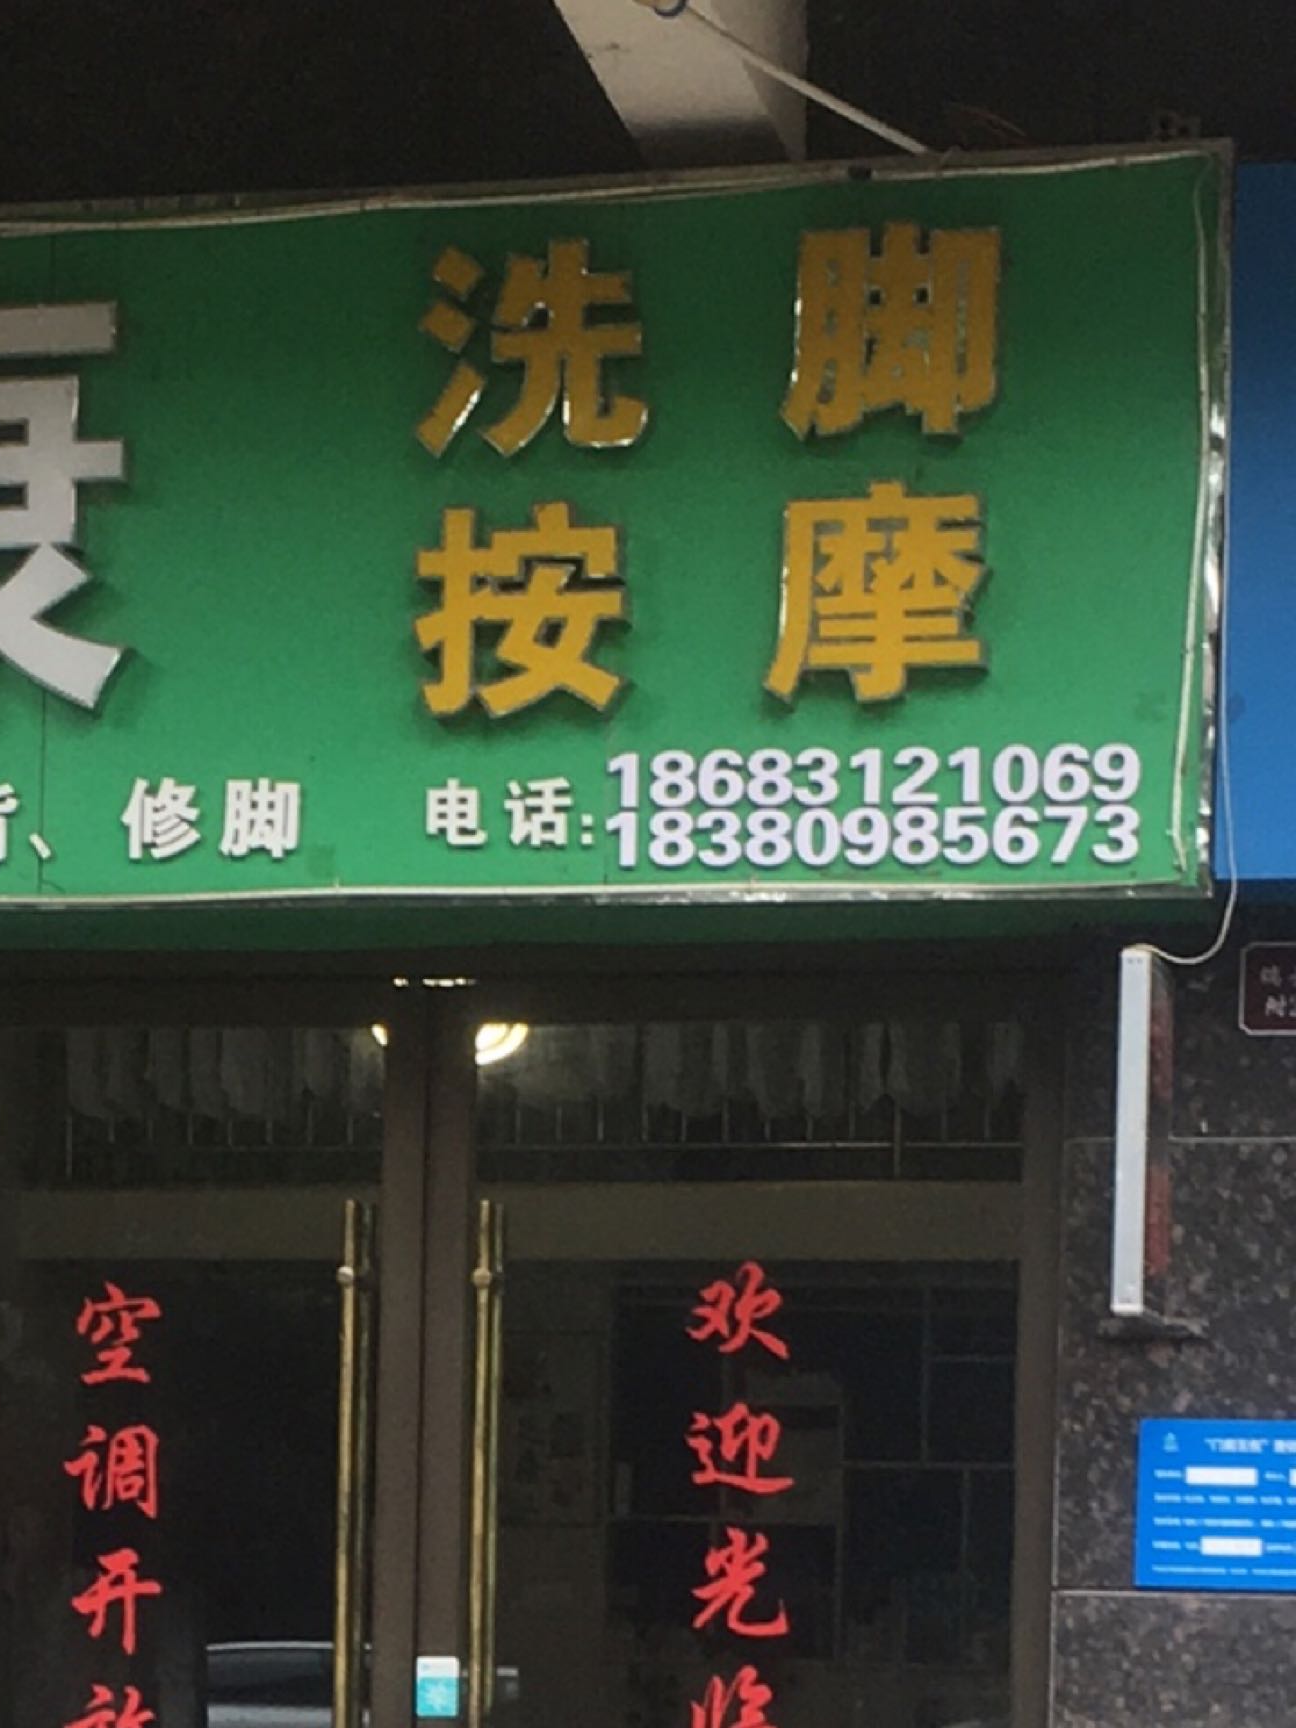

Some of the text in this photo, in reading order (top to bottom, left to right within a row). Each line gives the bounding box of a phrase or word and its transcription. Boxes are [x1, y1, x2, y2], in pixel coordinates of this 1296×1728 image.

[416, 222, 1001, 456] 洗脚
[412, 480, 990, 716] 按摩
[606, 806, 1141, 868] 18380985673
[607, 743, 1141, 808] 18683121069
